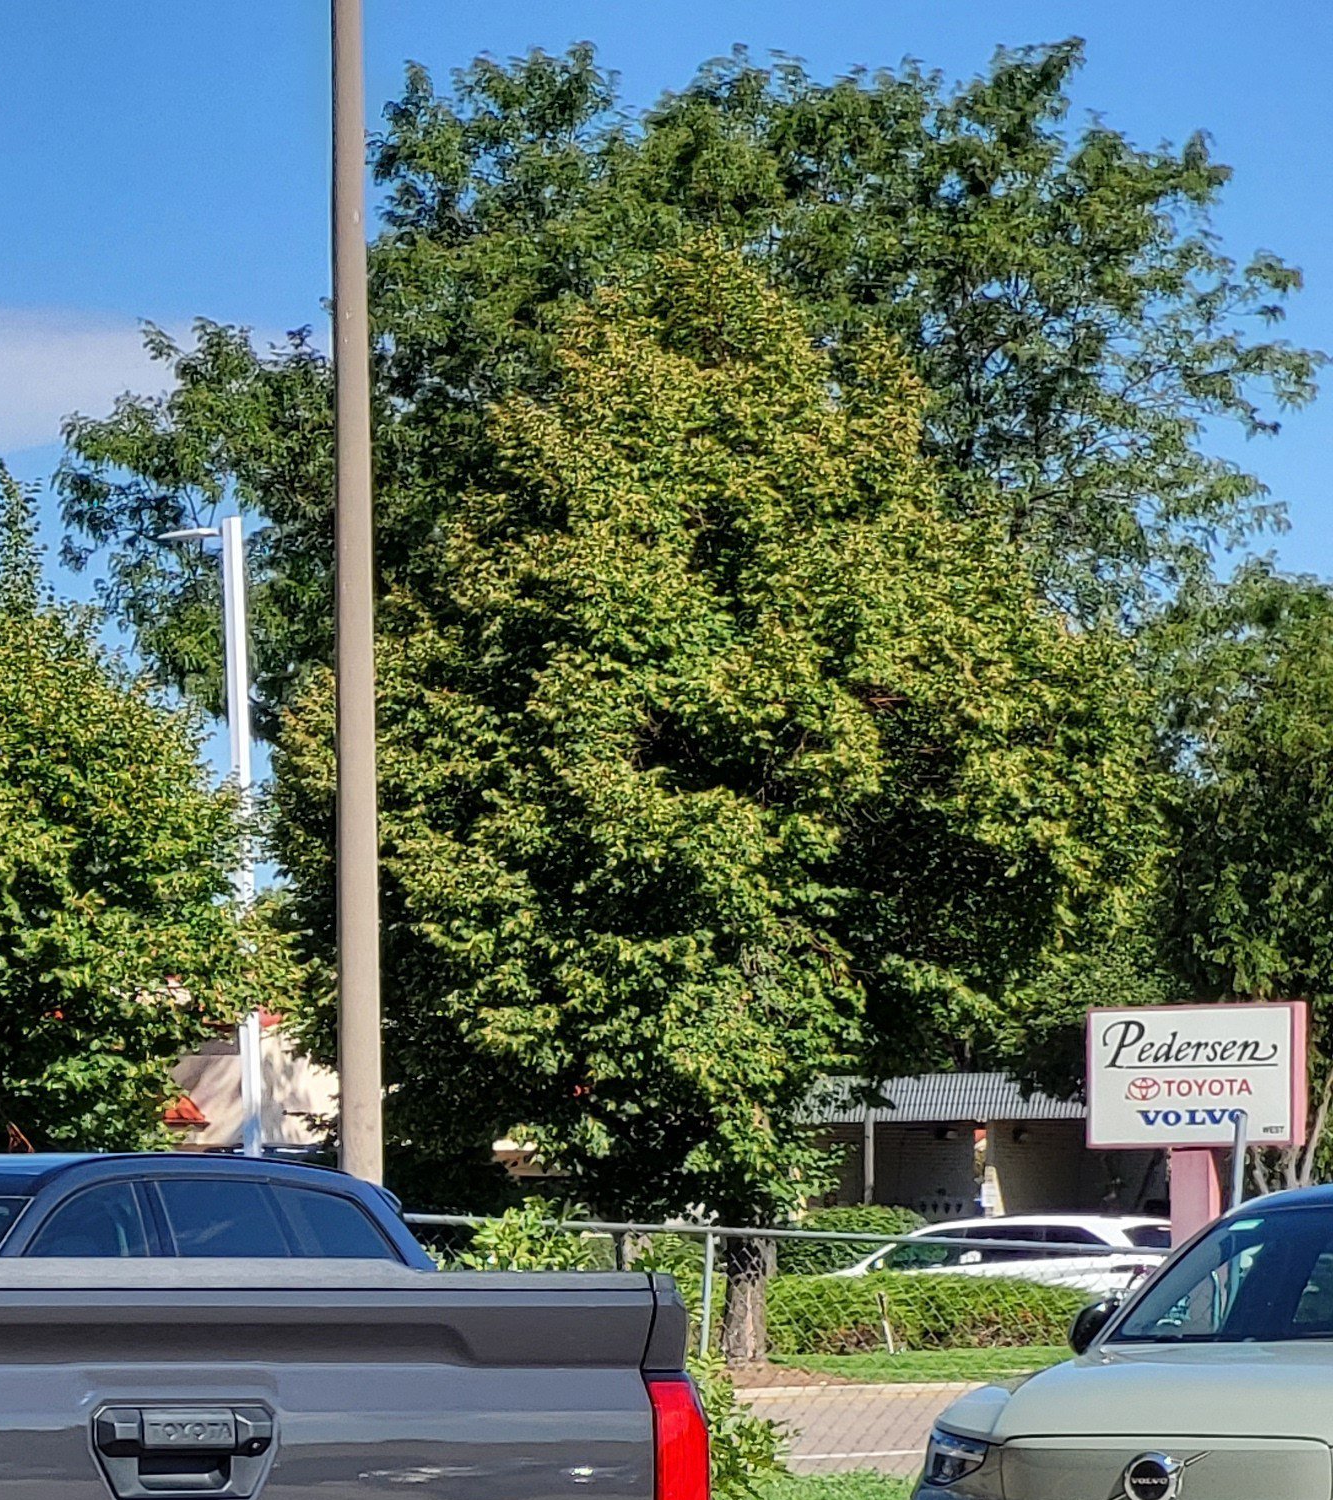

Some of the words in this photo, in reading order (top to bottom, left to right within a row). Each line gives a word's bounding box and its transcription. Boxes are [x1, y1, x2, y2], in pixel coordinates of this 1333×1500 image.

[1102, 1020, 1278, 1069] Pedersen
[1163, 1078, 1253, 1098] TOYOTA
[1262, 1126, 1285, 1134] WEST
[149, 1422, 233, 1441] TOYOTA
[1131, 1477, 1169, 1485] VOLVO
